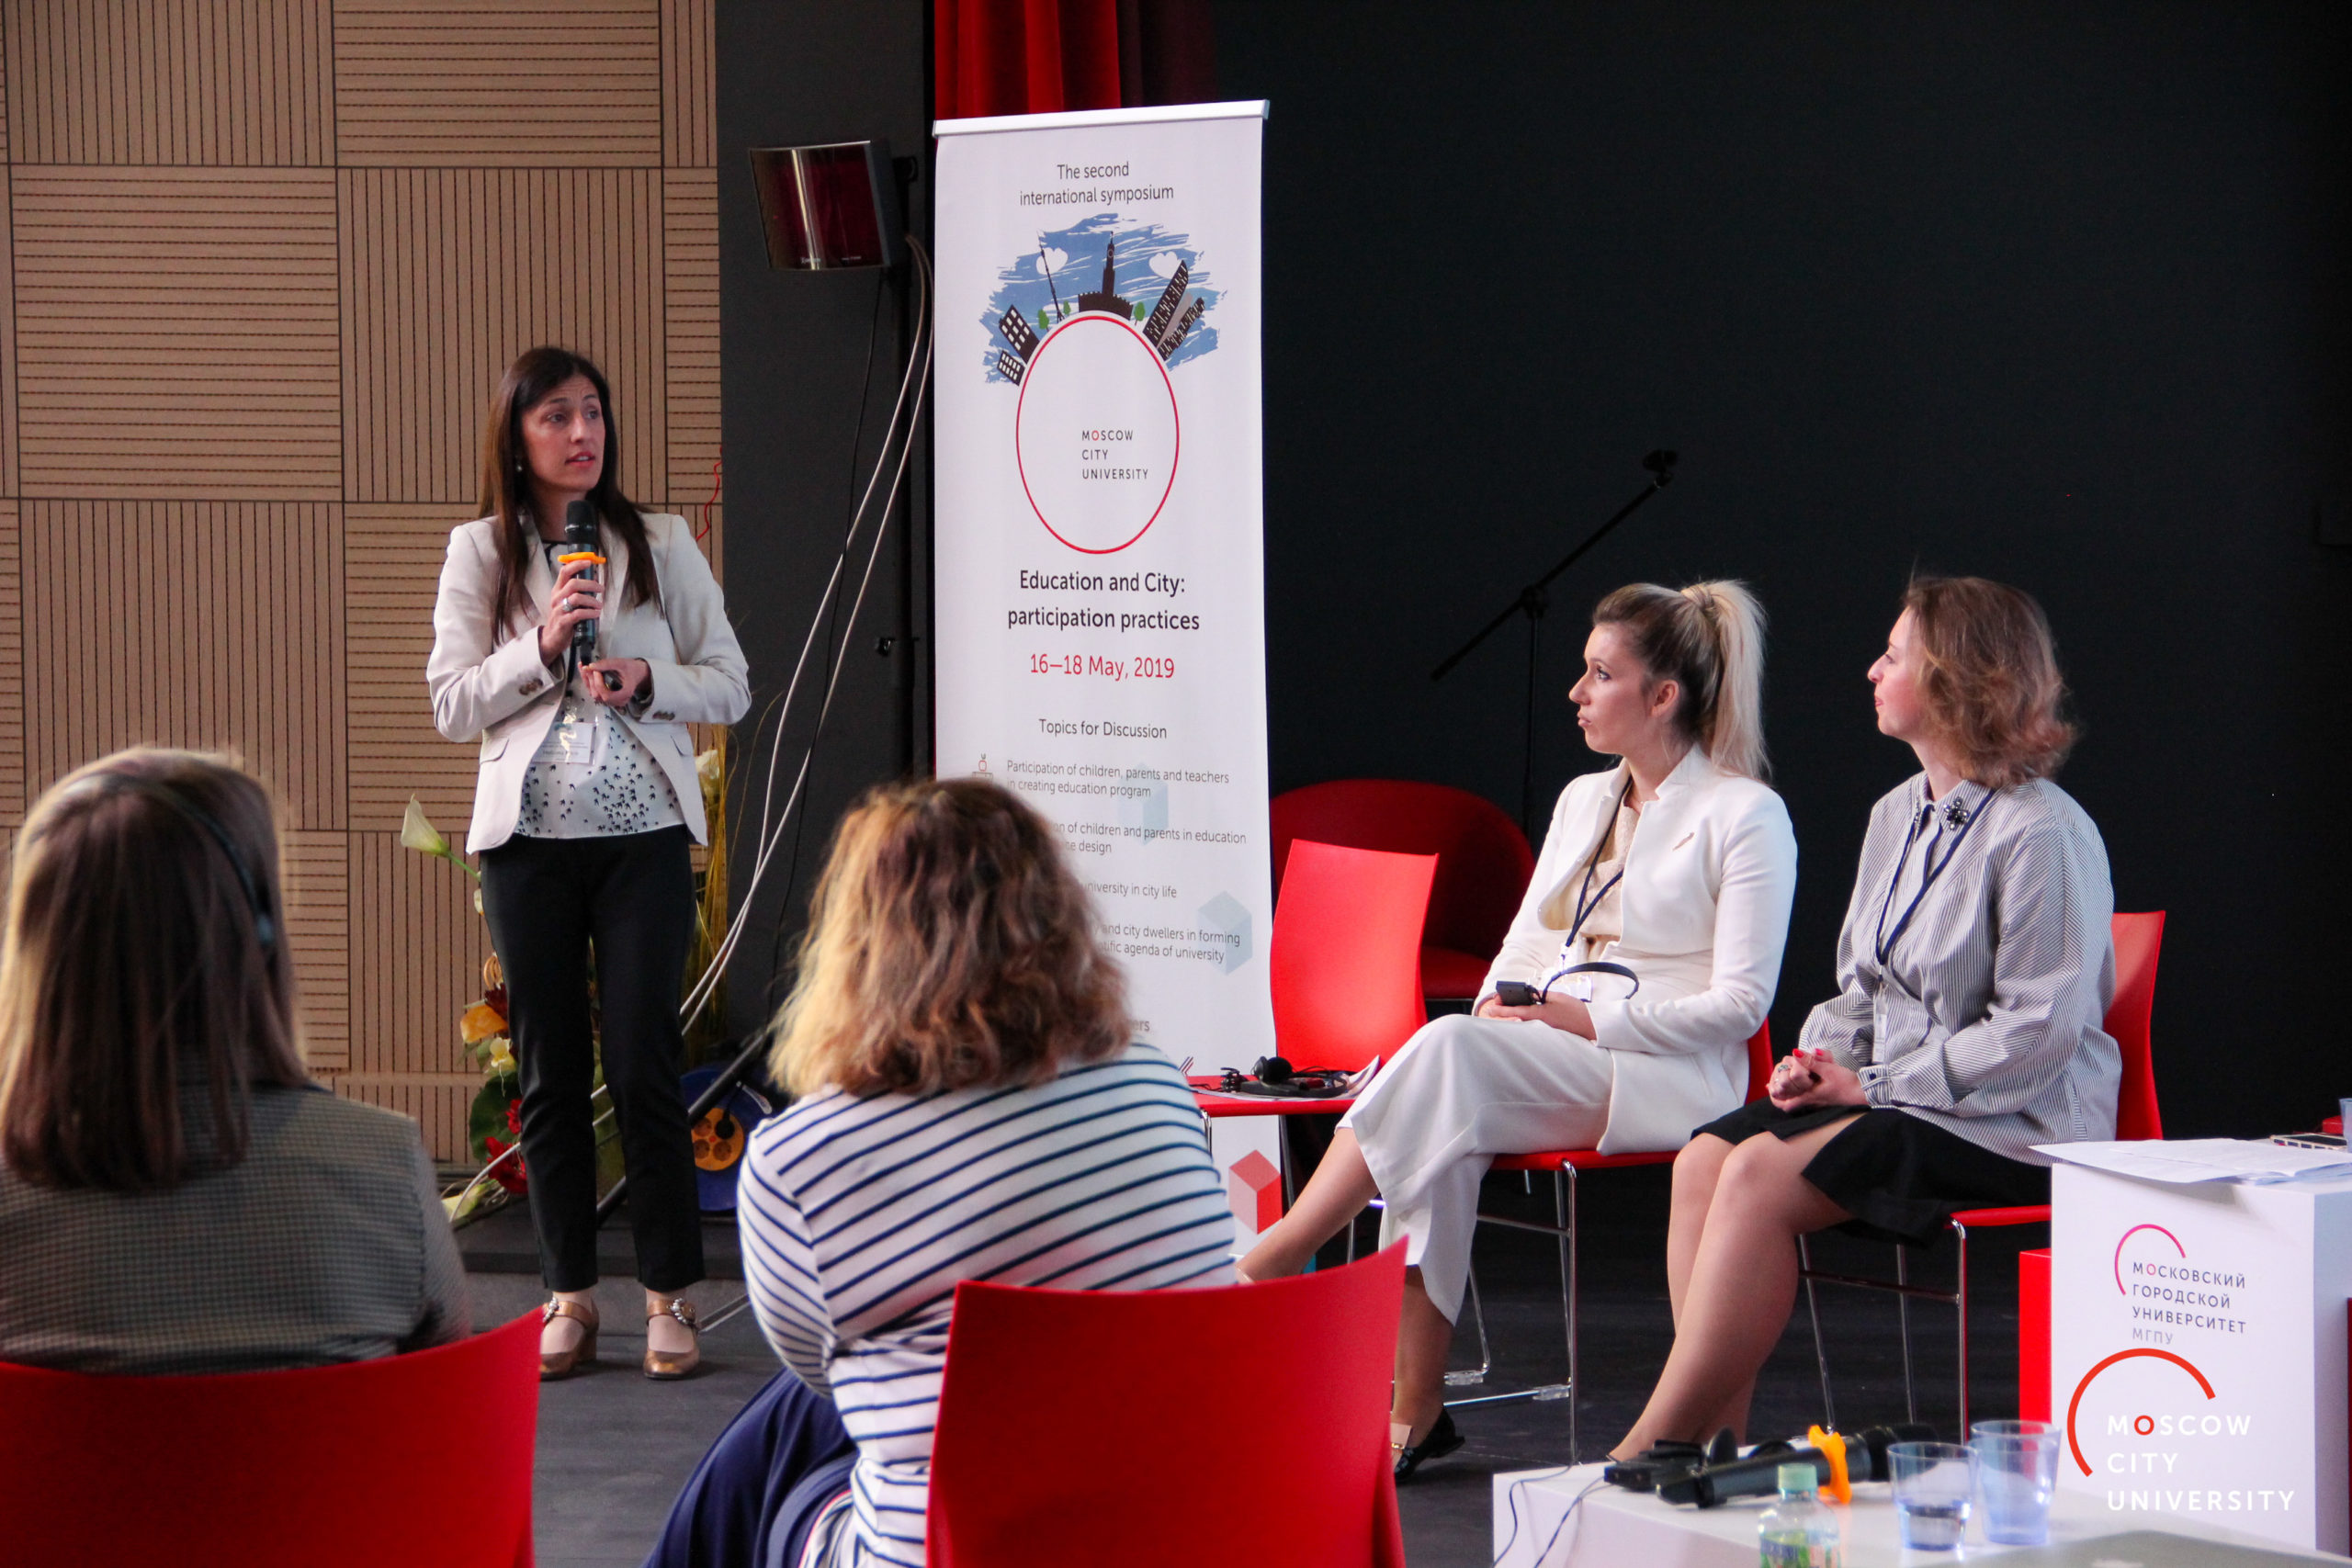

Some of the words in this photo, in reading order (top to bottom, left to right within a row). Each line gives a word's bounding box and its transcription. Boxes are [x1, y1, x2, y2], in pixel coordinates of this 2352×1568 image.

[1057, 164, 1080, 179] The
[1083, 161, 1129, 179] second
[1020, 186, 1097, 206] international
[1101, 184, 1174, 204] symposium
[1081, 429, 1134, 441] MOSCOW
[1081, 449, 1109, 460] CITY
[1081, 468, 1148, 479] UNIVERSITY
[1020, 570, 1103, 591] Education
[1109, 572, 1139, 592] and
[1145, 572, 1185, 597] City:
[1008, 606, 1115, 631] participation
[1121, 610, 1200, 633] practices
[1089, 655, 1129, 682] May,
[1134, 657, 1175, 678] 2019
[1038, 718, 1077, 737] Topics
[1080, 720, 1099, 736] for
[1103, 721, 1167, 739] Discussion
[1007, 760, 1064, 775] Participation
[1068, 763, 1077, 775] of
[1080, 764, 1123, 779] children,
[1126, 768, 1160, 781] parents
[1163, 770, 1182, 781] and
[1185, 771, 1229, 784] teachers
[1018, 779, 1056, 795] creating
[1057, 782, 1107, 795] education
[1110, 785, 1151, 799] program
[1068, 822, 1078, 833] of
[1080, 823, 1121, 836] children
[1124, 826, 1141, 838] and
[1144, 828, 1180, 840] parents
[1183, 829, 1193, 840] in
[1195, 829, 1247, 844] education
[1079, 840, 1112, 855] design
[1131, 883, 1140, 895] in
[1143, 884, 1159, 899] city
[1162, 885, 1177, 897] life
[1124, 925, 1140, 939] city
[1143, 926, 1184, 940] dwellers
[1187, 929, 1196, 941] in
[1199, 930, 1240, 947] forming
[1124, 943, 1159, 956] agenda
[1162, 945, 1173, 957] of
[1176, 947, 1226, 964] university
[2132, 1261, 2245, 1289] МОСКОВСКИЙ
[2132, 1283, 2231, 1309] ГОРОДСКОЙ
[2132, 1306, 2246, 1334] УНИВЕРСИТЕТ
[2132, 1327, 2174, 1344] МГПУ
